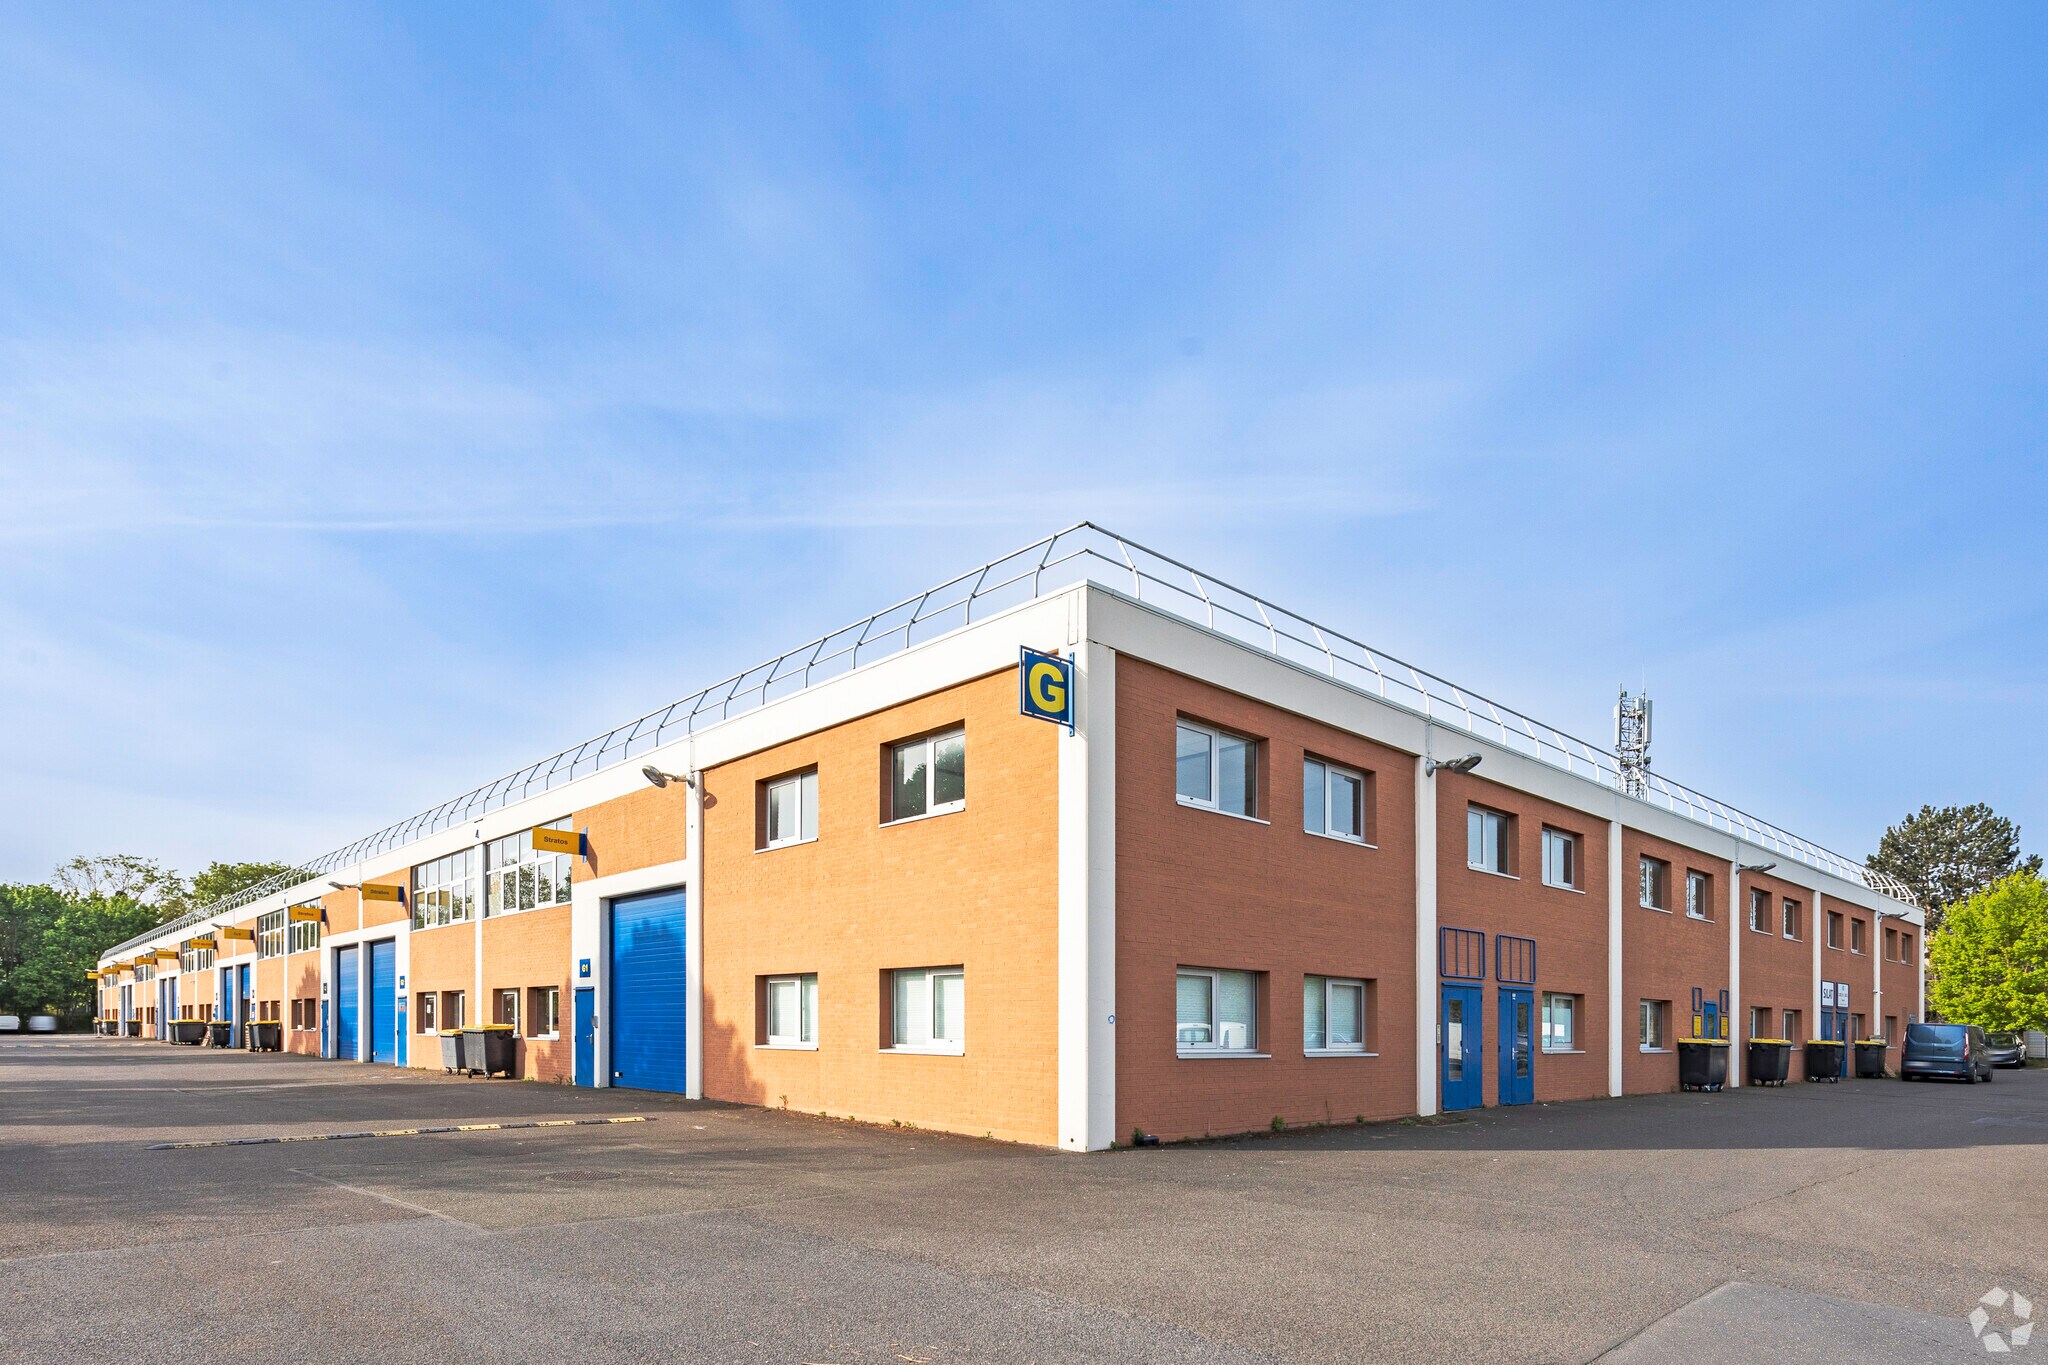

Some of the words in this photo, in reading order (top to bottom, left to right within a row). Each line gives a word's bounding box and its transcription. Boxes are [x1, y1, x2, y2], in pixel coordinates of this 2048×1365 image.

[1029, 662, 1065, 713] G
[543, 836, 569, 846] Stratos
[581, 964, 589, 973] G1
